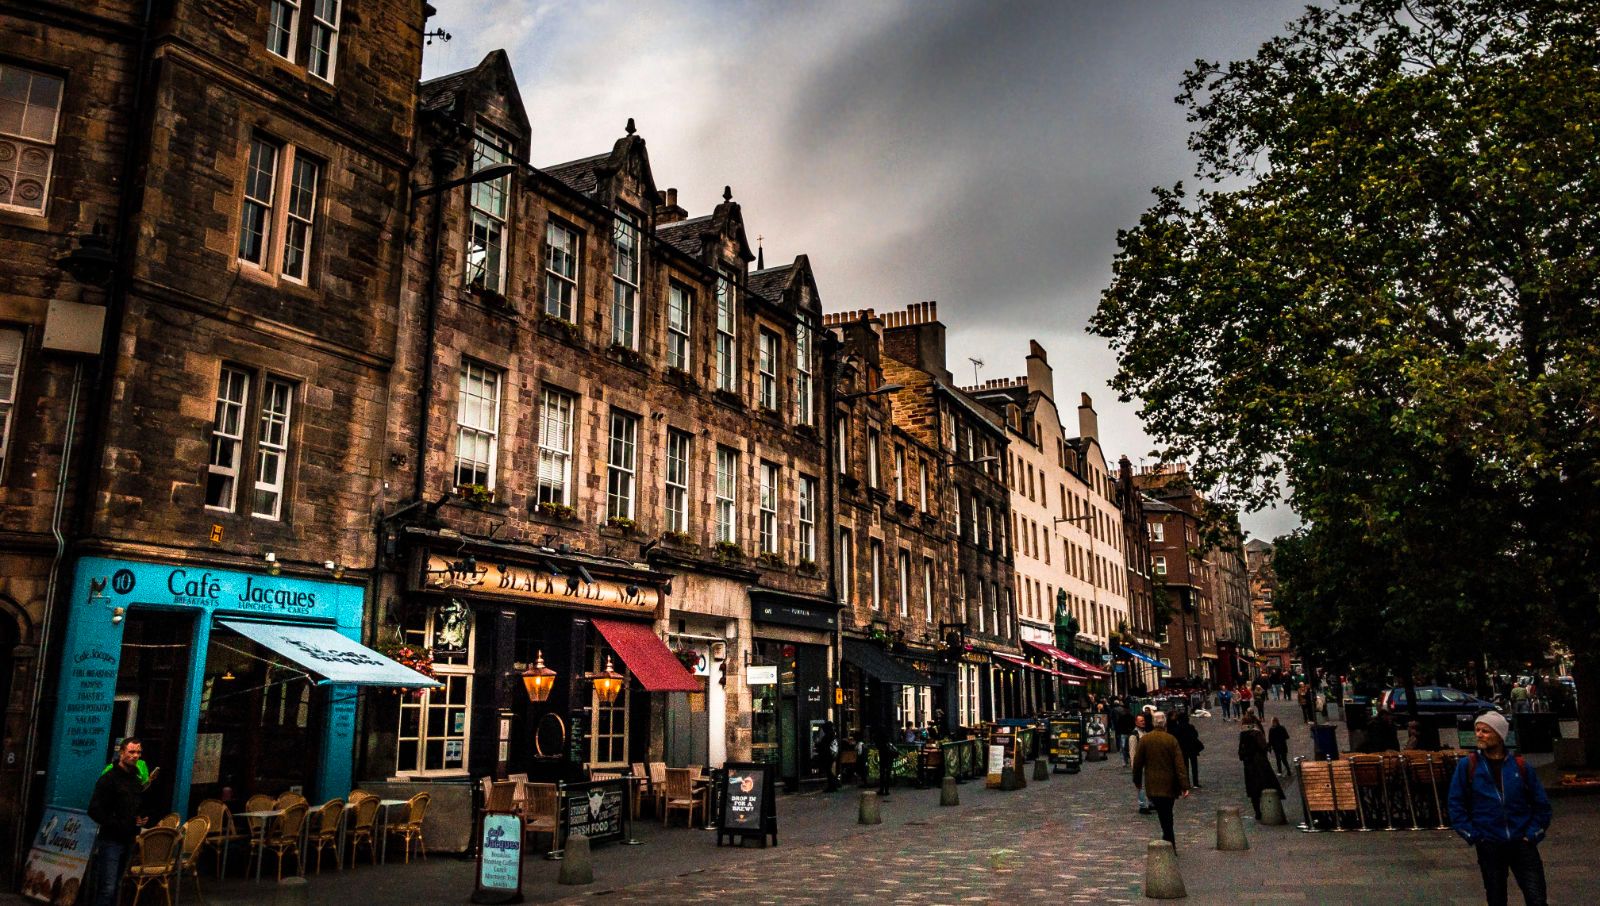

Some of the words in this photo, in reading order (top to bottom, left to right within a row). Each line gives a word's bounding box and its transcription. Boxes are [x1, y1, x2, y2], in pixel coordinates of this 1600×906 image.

[115, 572, 131, 591] 10
[167, 569, 221, 599] Café
[238, 577, 316, 608] Jacques
[497, 570, 554, 595] BLACK
[563, 577, 605, 601] BULL
[174, 596, 220, 607] BREAKFASTS
[238, 601, 273, 612] LUNCHES
[287, 606, 310, 615] CAKES
[591, 820, 609, 833] FOOD
[484, 836, 520, 852] Jacques
